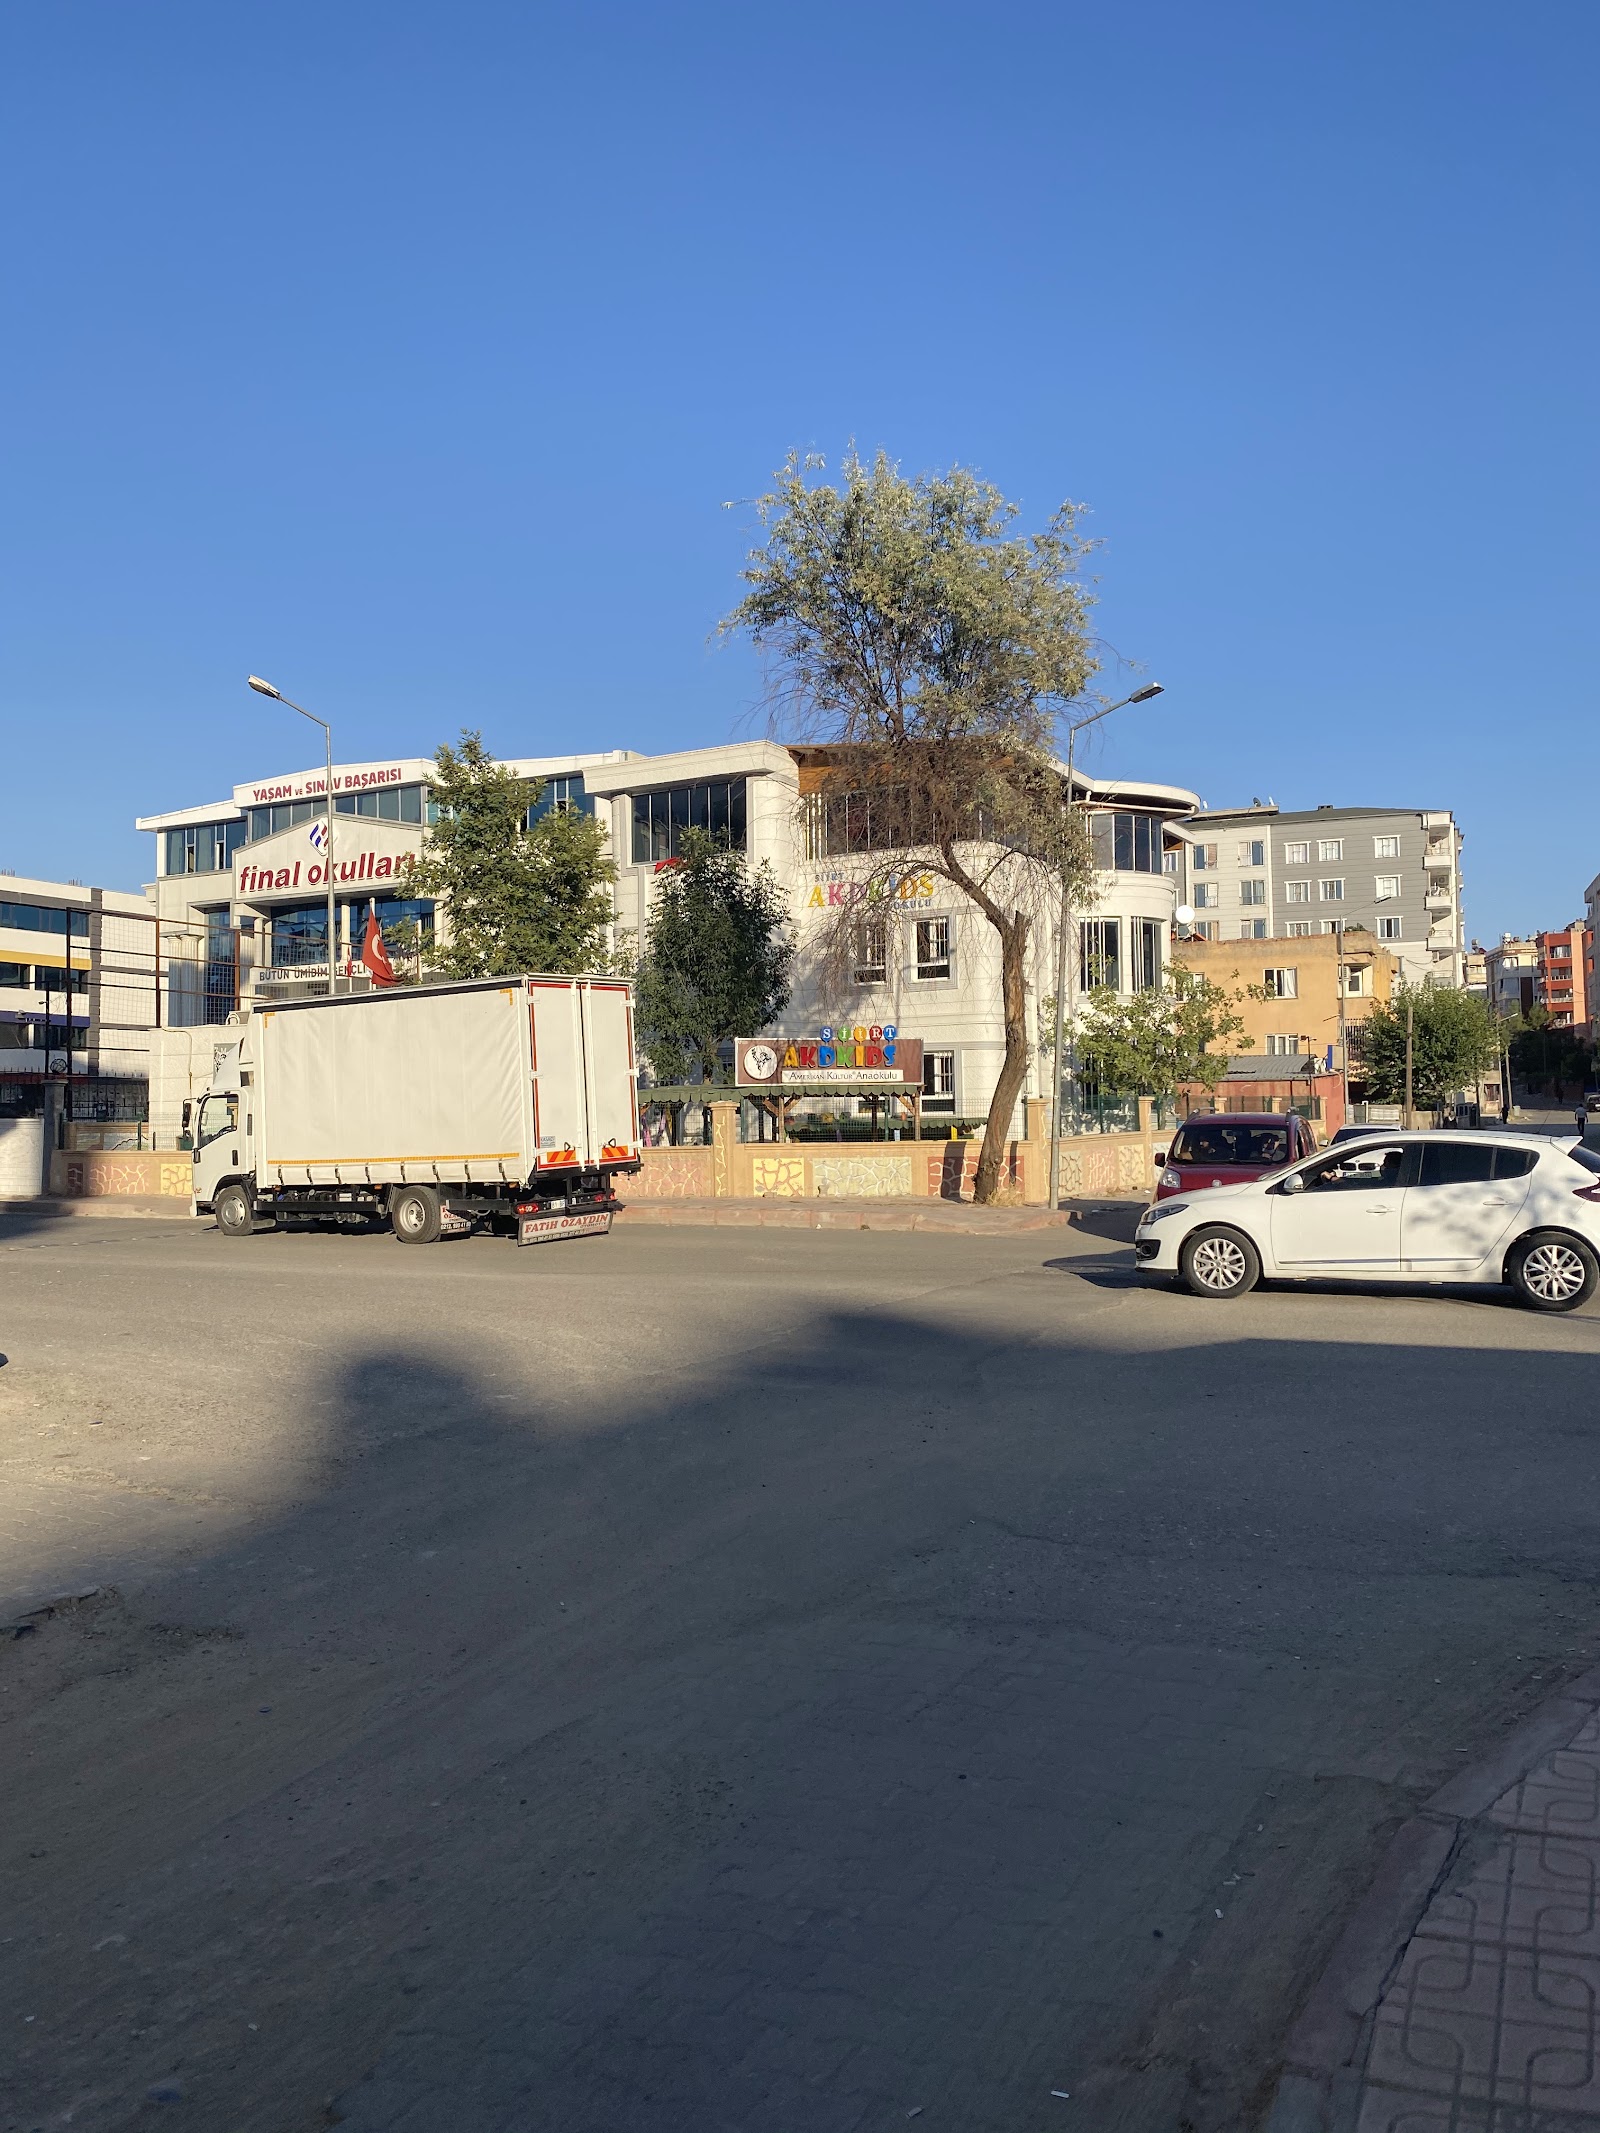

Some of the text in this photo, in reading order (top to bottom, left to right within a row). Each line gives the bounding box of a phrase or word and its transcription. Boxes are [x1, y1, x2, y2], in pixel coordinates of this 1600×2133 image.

[253, 784, 292, 802] YAŞAM
[305, 776, 342, 794] SINAV
[345, 767, 402, 789] BAŞARISI
[239, 860, 301, 892] final
[783, 1044, 897, 1069] AKDKIDS
